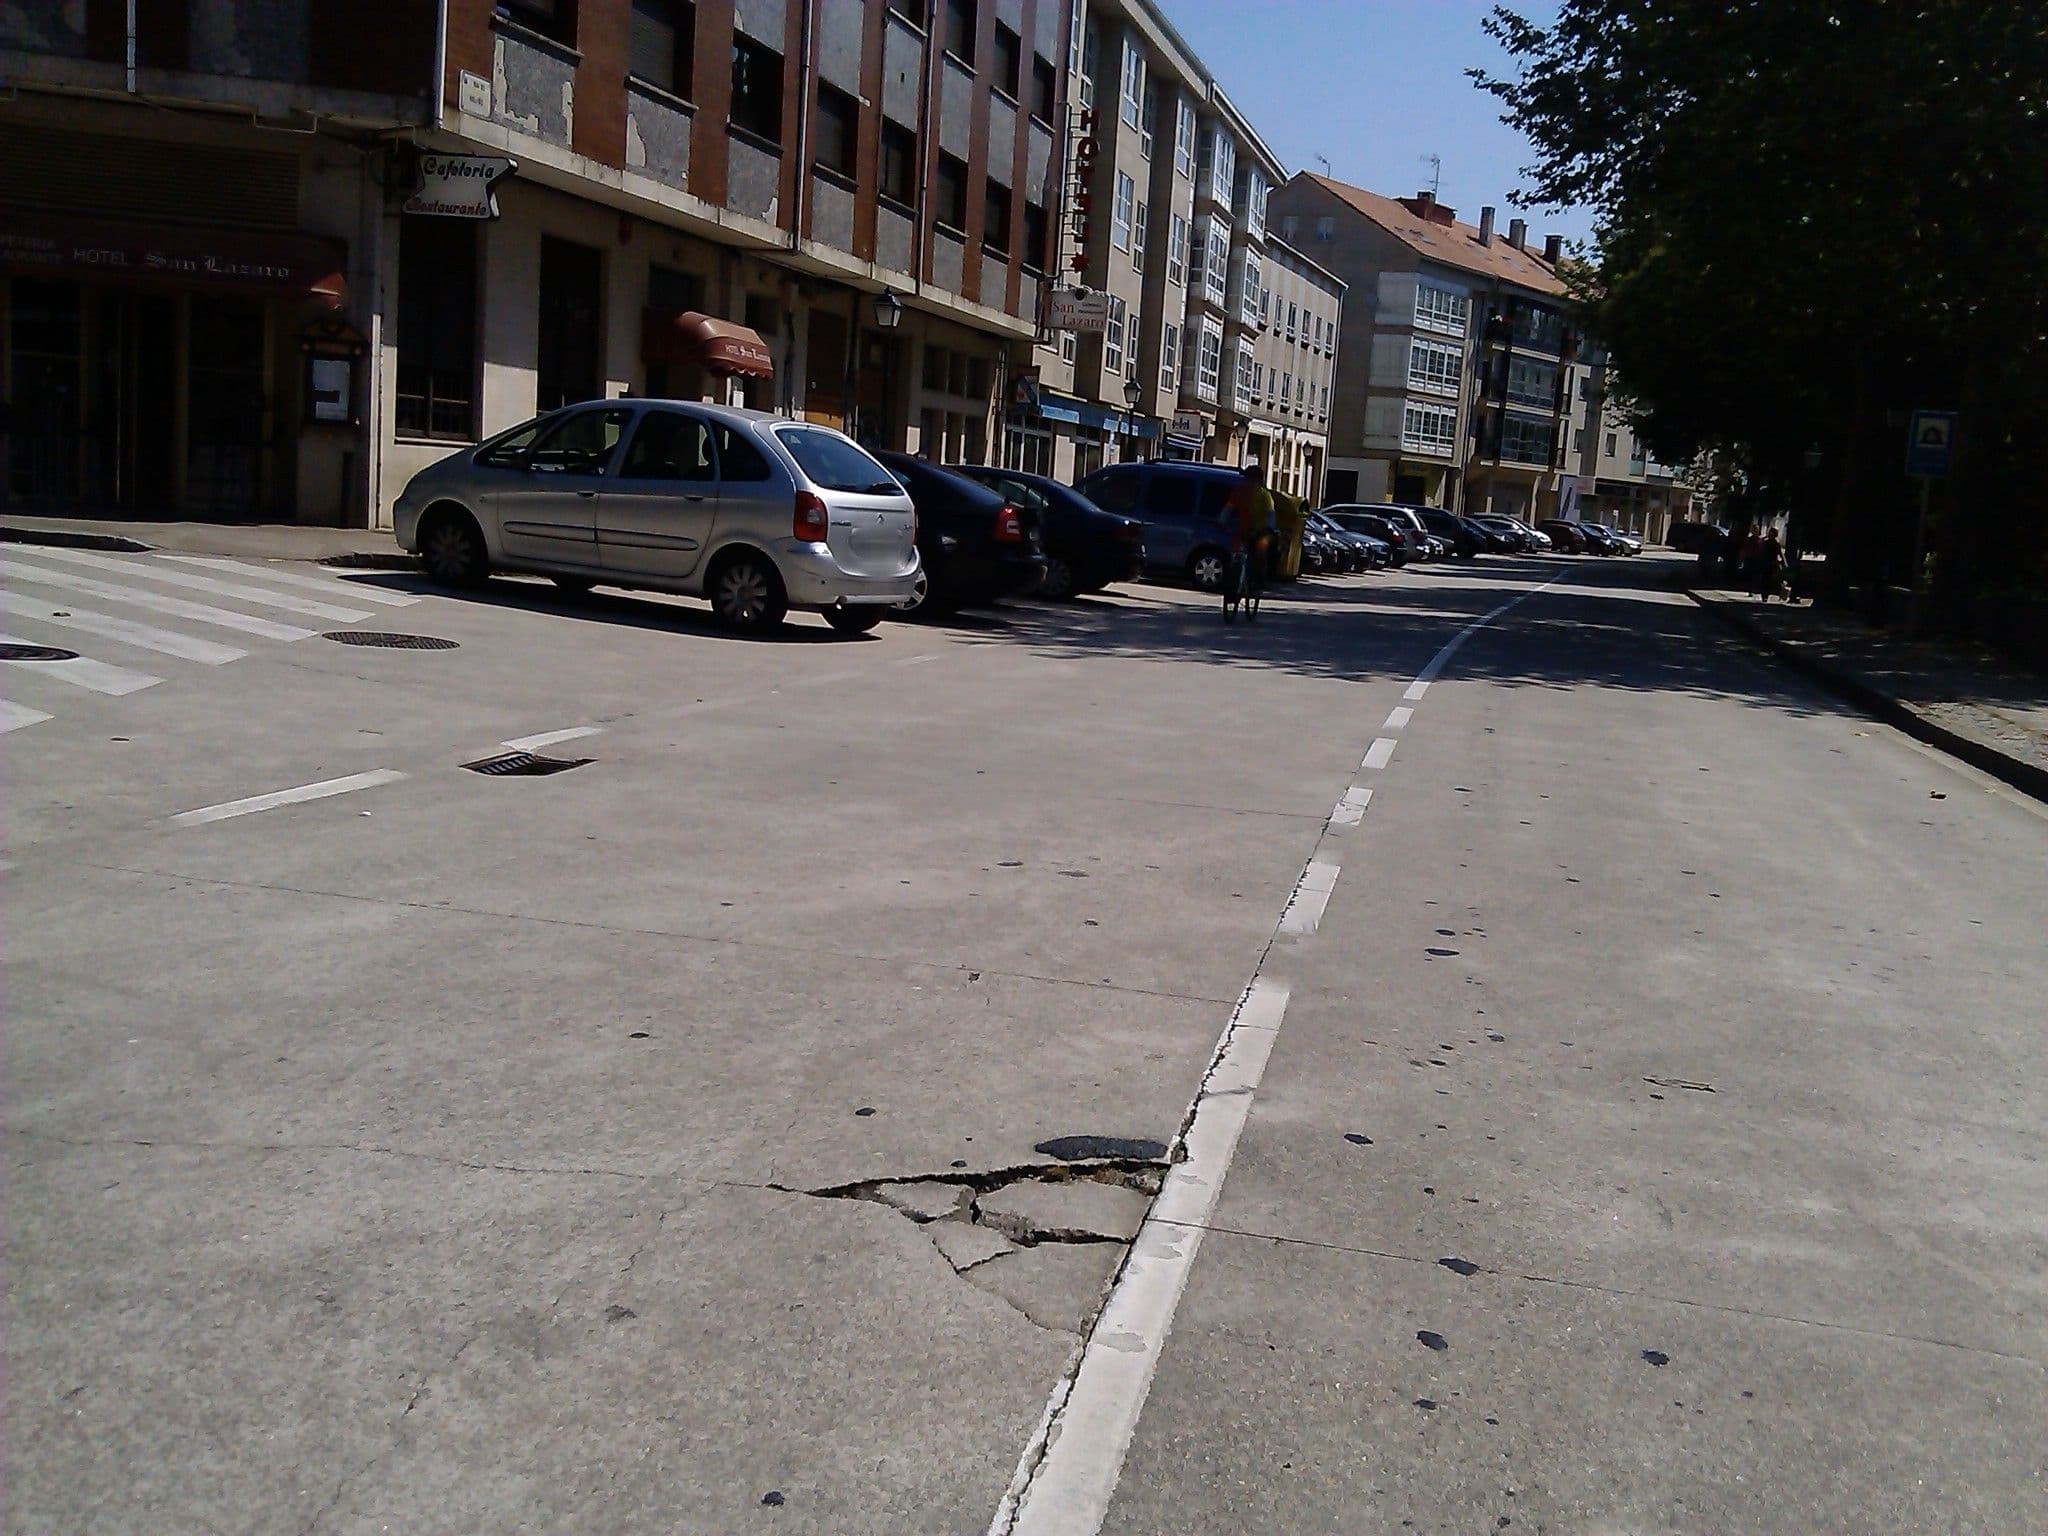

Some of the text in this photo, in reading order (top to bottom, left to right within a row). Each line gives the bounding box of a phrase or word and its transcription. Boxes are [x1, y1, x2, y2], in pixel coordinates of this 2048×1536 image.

[1075, 109, 1099, 243] HOTEL
[73, 247, 128, 266] HOTEL
[1053, 301, 1074, 314] San
